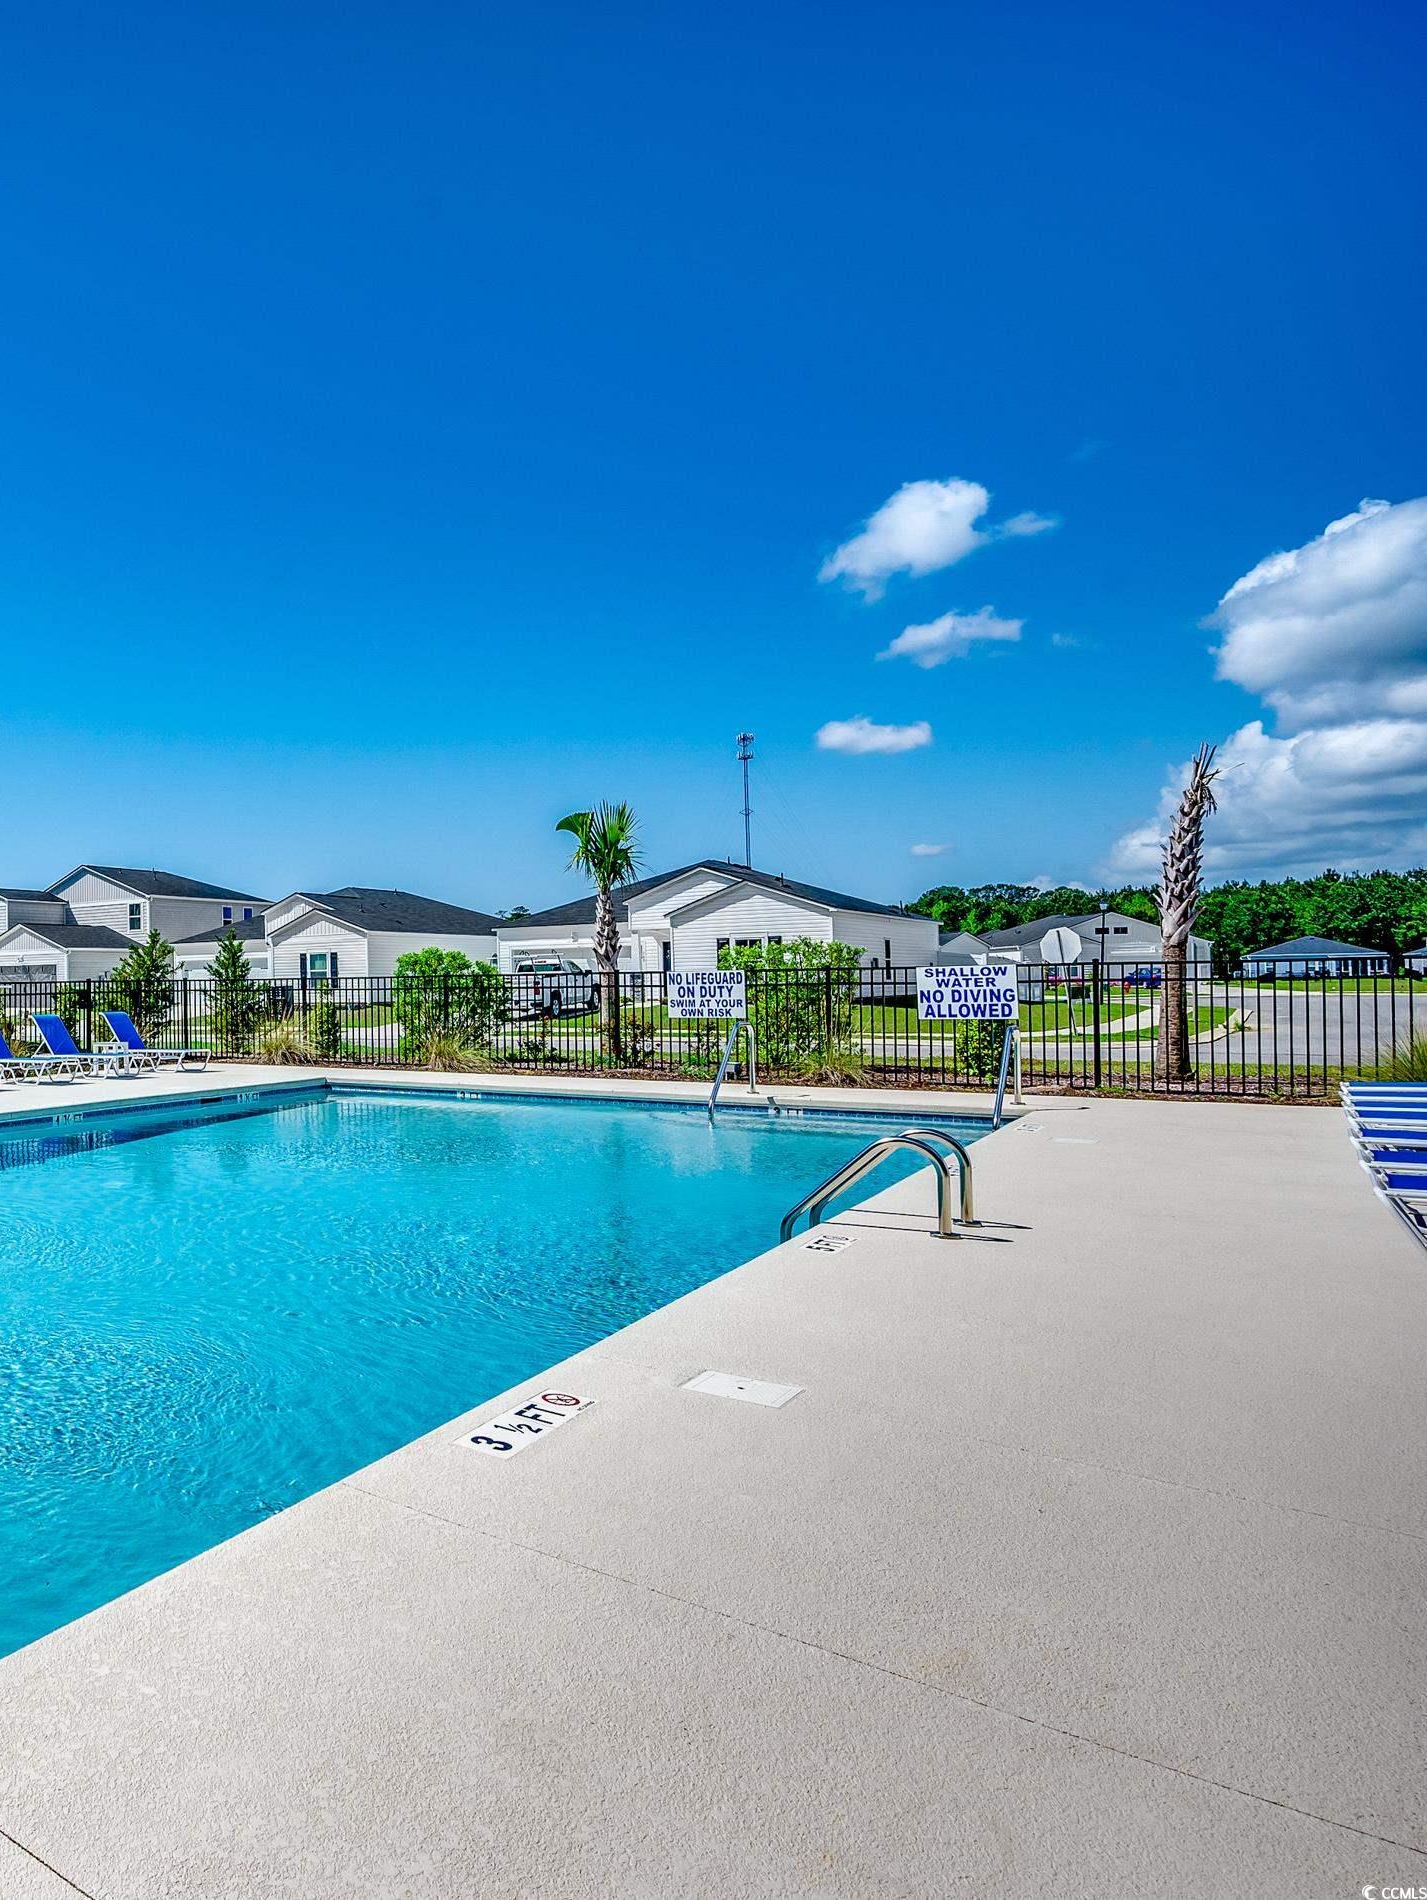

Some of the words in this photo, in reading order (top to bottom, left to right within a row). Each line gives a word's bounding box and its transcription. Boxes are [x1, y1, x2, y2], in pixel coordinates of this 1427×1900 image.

[668, 973, 683, 985] NO
[685, 972, 743, 985] LIFEGUARD
[924, 966, 1008, 978] SHALLOW
[935, 977, 997, 988] WATER
[677, 986, 695, 998] ON
[699, 985, 734, 998] DUTY
[919, 989, 944, 1003] NO
[951, 988, 1016, 1003] DIVING
[670, 999, 696, 1008] SWIM
[699, 999, 711, 1008] AT
[715, 999, 744, 1008] YOUR
[680, 1008, 704, 1017] OWN
[707, 1008, 733, 1017] RISK
[924, 1003, 1013, 1018] ALLOWED
[470, 1435, 514, 1452] 3
[514, 1403, 566, 1425] FT
